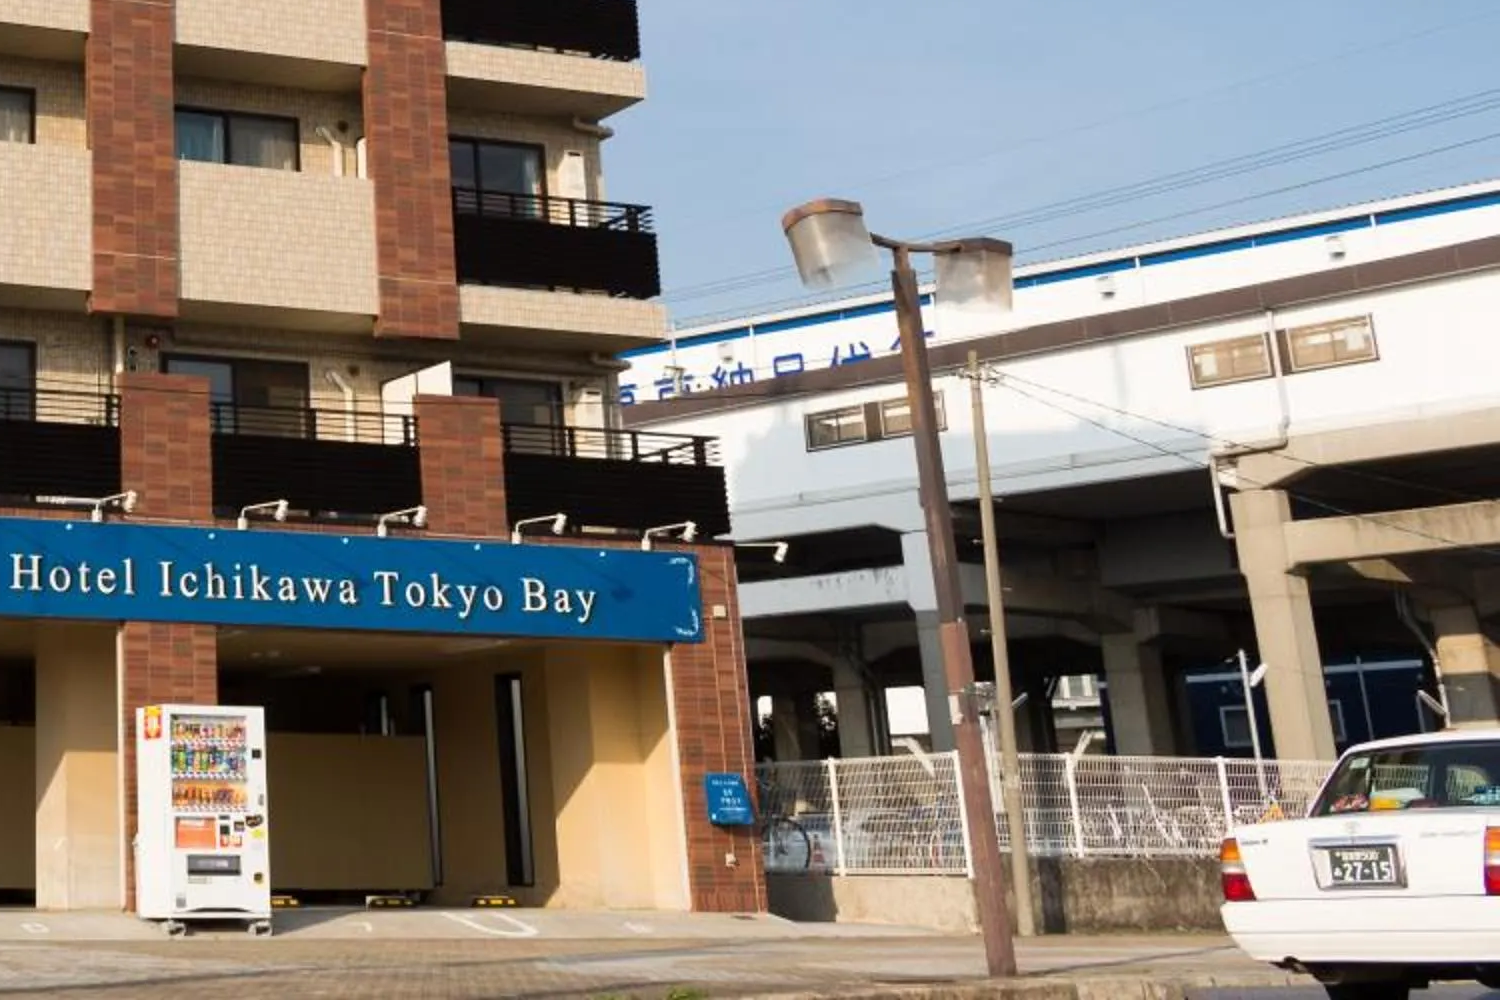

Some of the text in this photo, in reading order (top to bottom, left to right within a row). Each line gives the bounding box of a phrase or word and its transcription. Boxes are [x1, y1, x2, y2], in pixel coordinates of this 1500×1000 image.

[10, 553, 135, 595] Hotel
[159, 561, 358, 604] Ichikawa
[374, 571, 504, 618] Tokyo
[520, 577, 596, 623] Bay
[1343, 861, 1390, 881] 27-15
